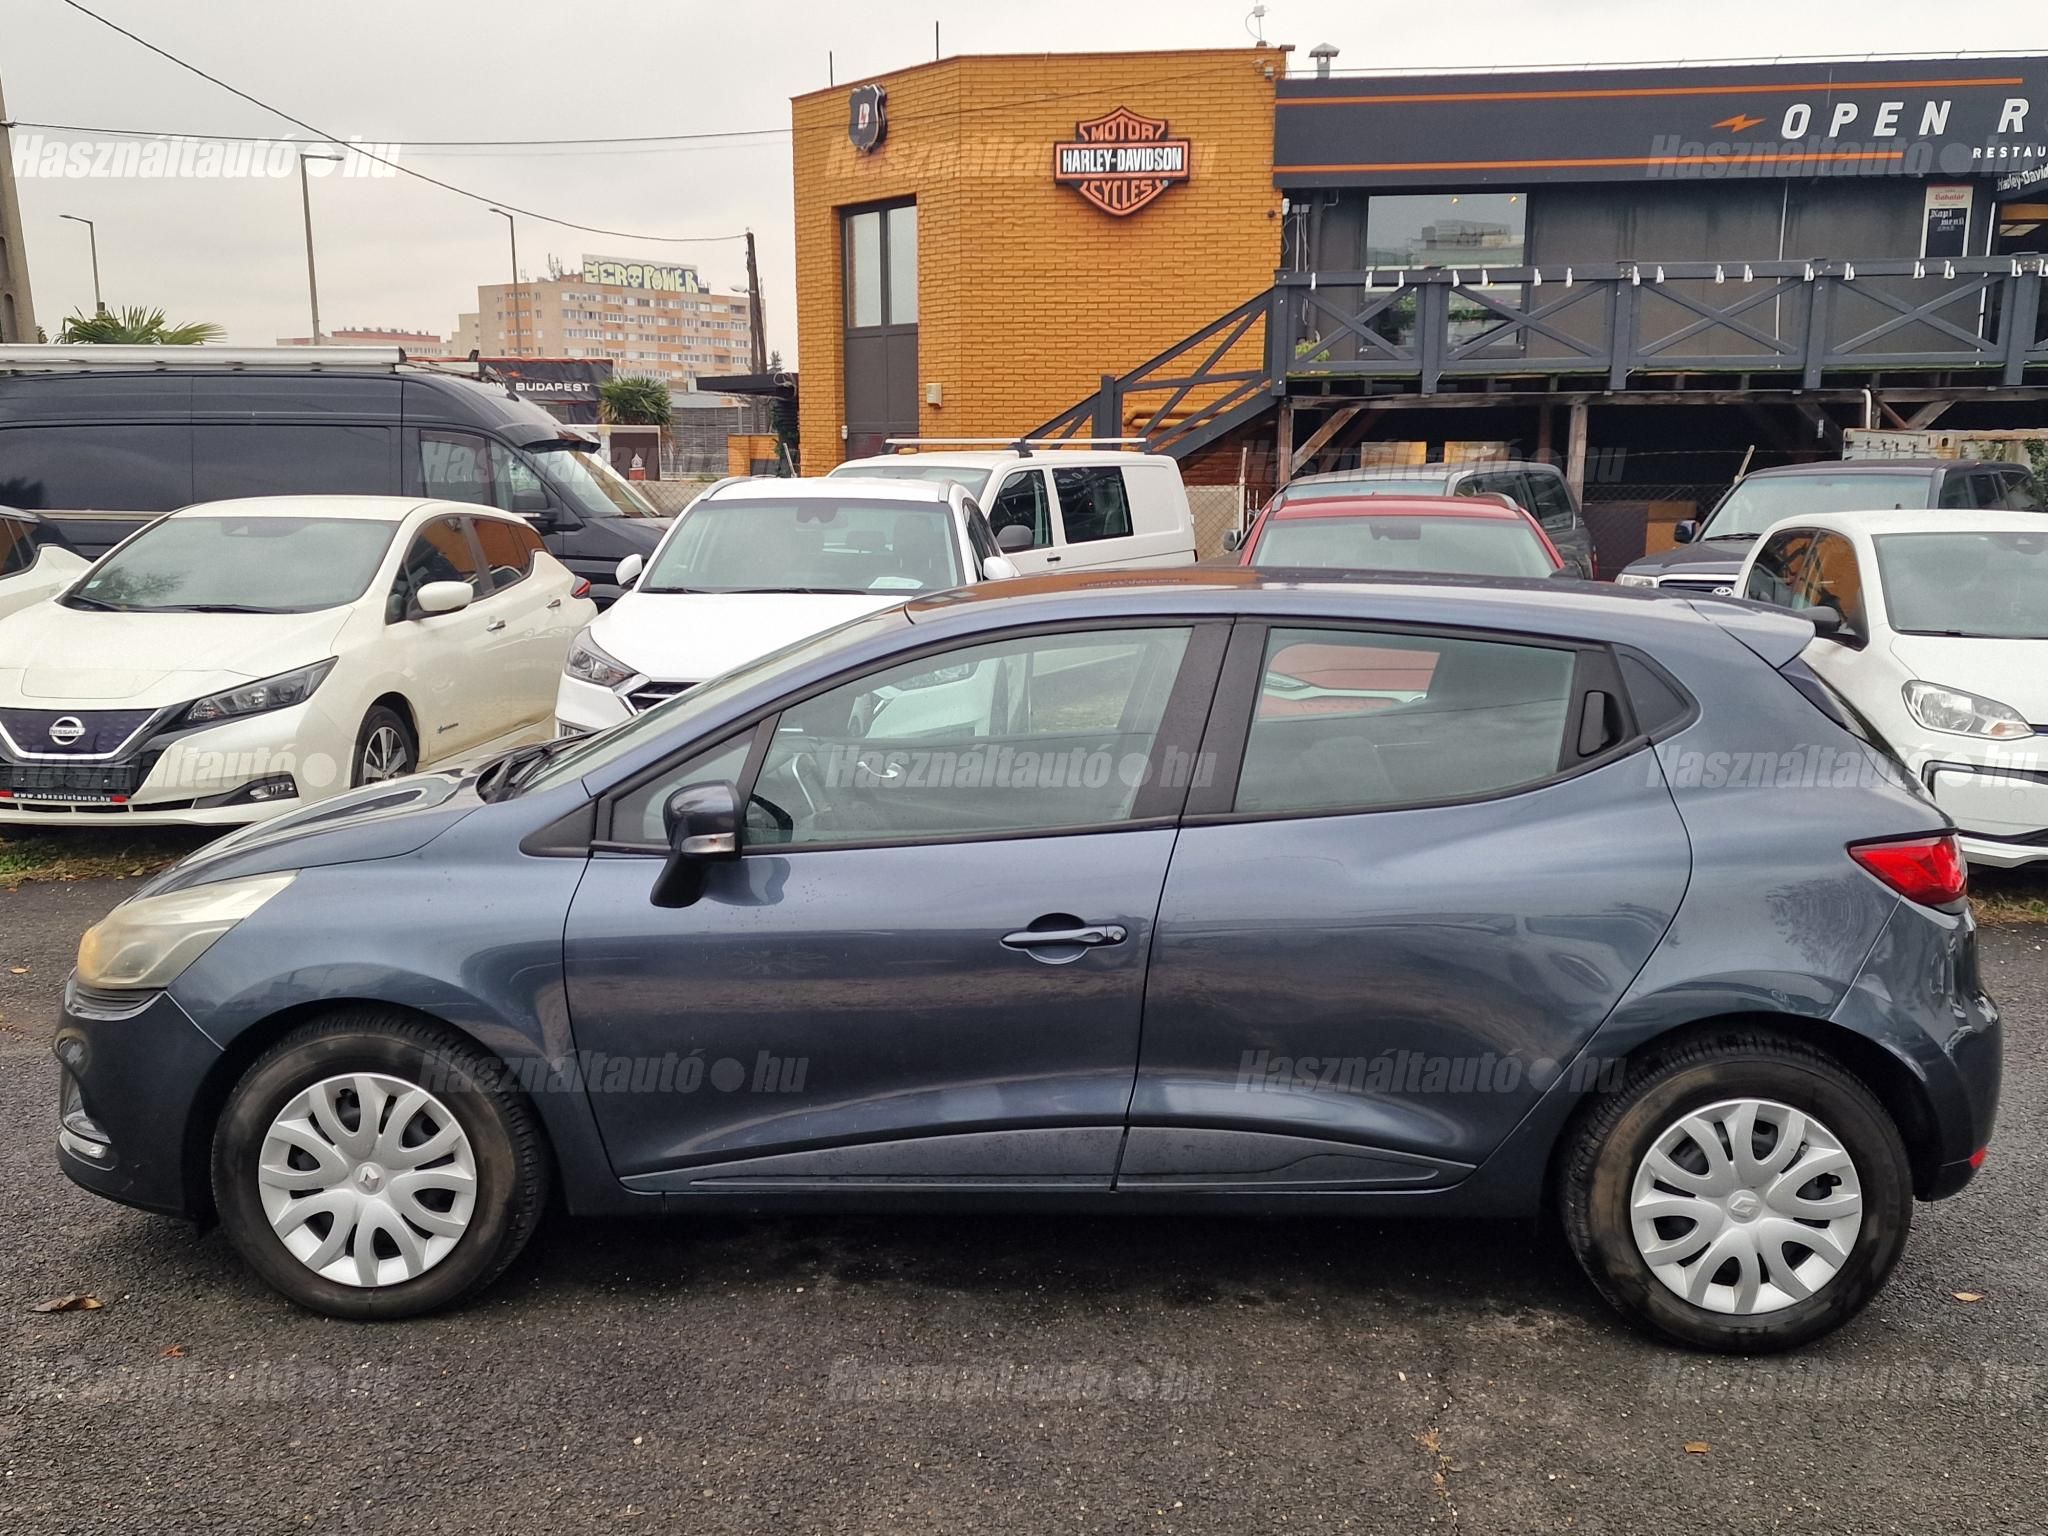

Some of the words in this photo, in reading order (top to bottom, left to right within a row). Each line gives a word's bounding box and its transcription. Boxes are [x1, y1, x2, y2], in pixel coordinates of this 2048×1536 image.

[1091, 115, 1154, 141] MOTOR
[1781, 100, 1952, 140] OPEN
[1062, 146, 1183, 173] HARLEY-DAVIDSON
[1972, 146, 2047, 159] RESTAU
[1089, 180, 1153, 209] CYCLES
[515, 382, 590, 392] BUDAPEST
